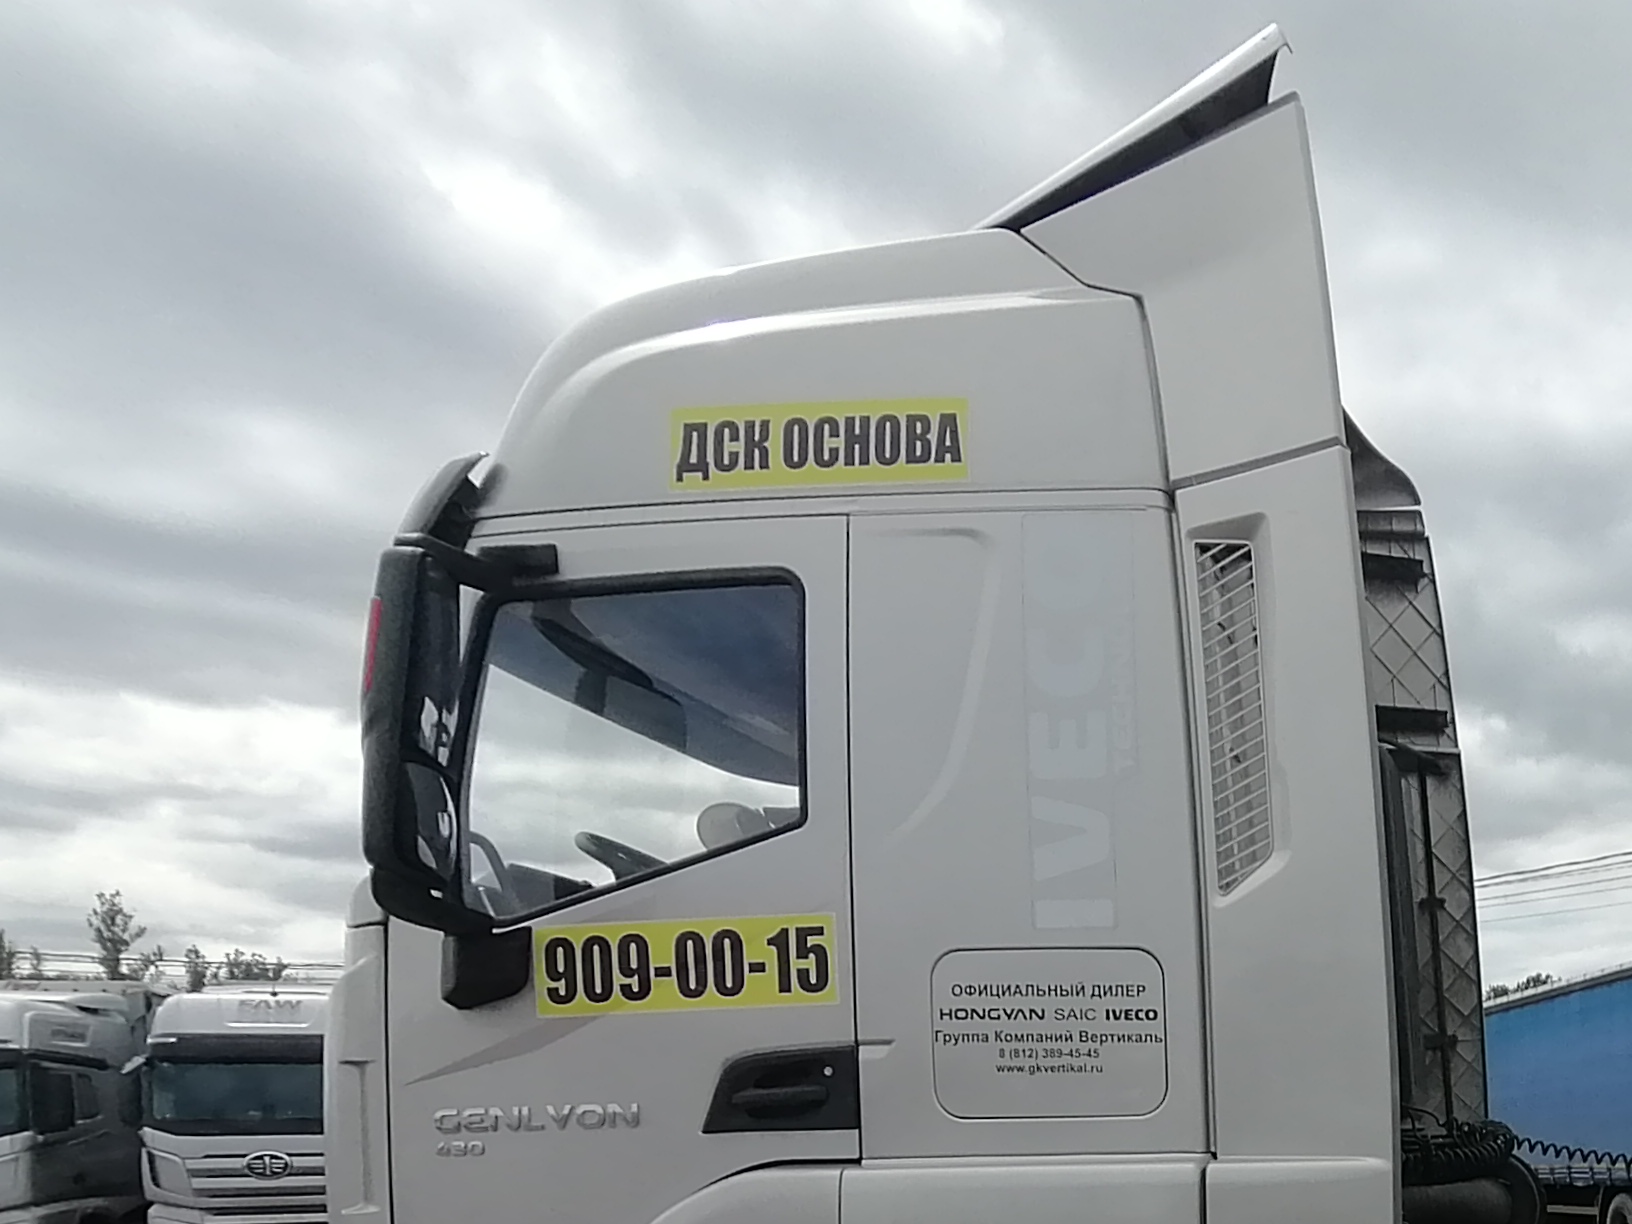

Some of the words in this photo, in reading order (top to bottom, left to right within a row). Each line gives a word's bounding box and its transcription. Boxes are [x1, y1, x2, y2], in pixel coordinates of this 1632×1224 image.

[676, 418, 770, 482] ДСК
[782, 412, 962, 469] ОСНОВА
[544, 926, 829, 1005] 909-00-15
[951, 982, 1086, 999] ОФИЦИАЛЬНЫЙ
[1090, 984, 1146, 999] ДИЛЕР
[939, 1008, 1045, 1021] HONGYAN
[1054, 1008, 1097, 1021] SAIC
[1105, 1008, 1158, 1021] IVECO
[935, 1030, 989, 1046] Группа
[994, 1030, 1073, 1043] Компаний
[1079, 1030, 1163, 1046] Вертикаль
[1009, 1048, 1038, 1061] (812)
[996, 1062, 1103, 1075] www.gkvertikal.ru
[434, 1103, 641, 1134] GENLYON
